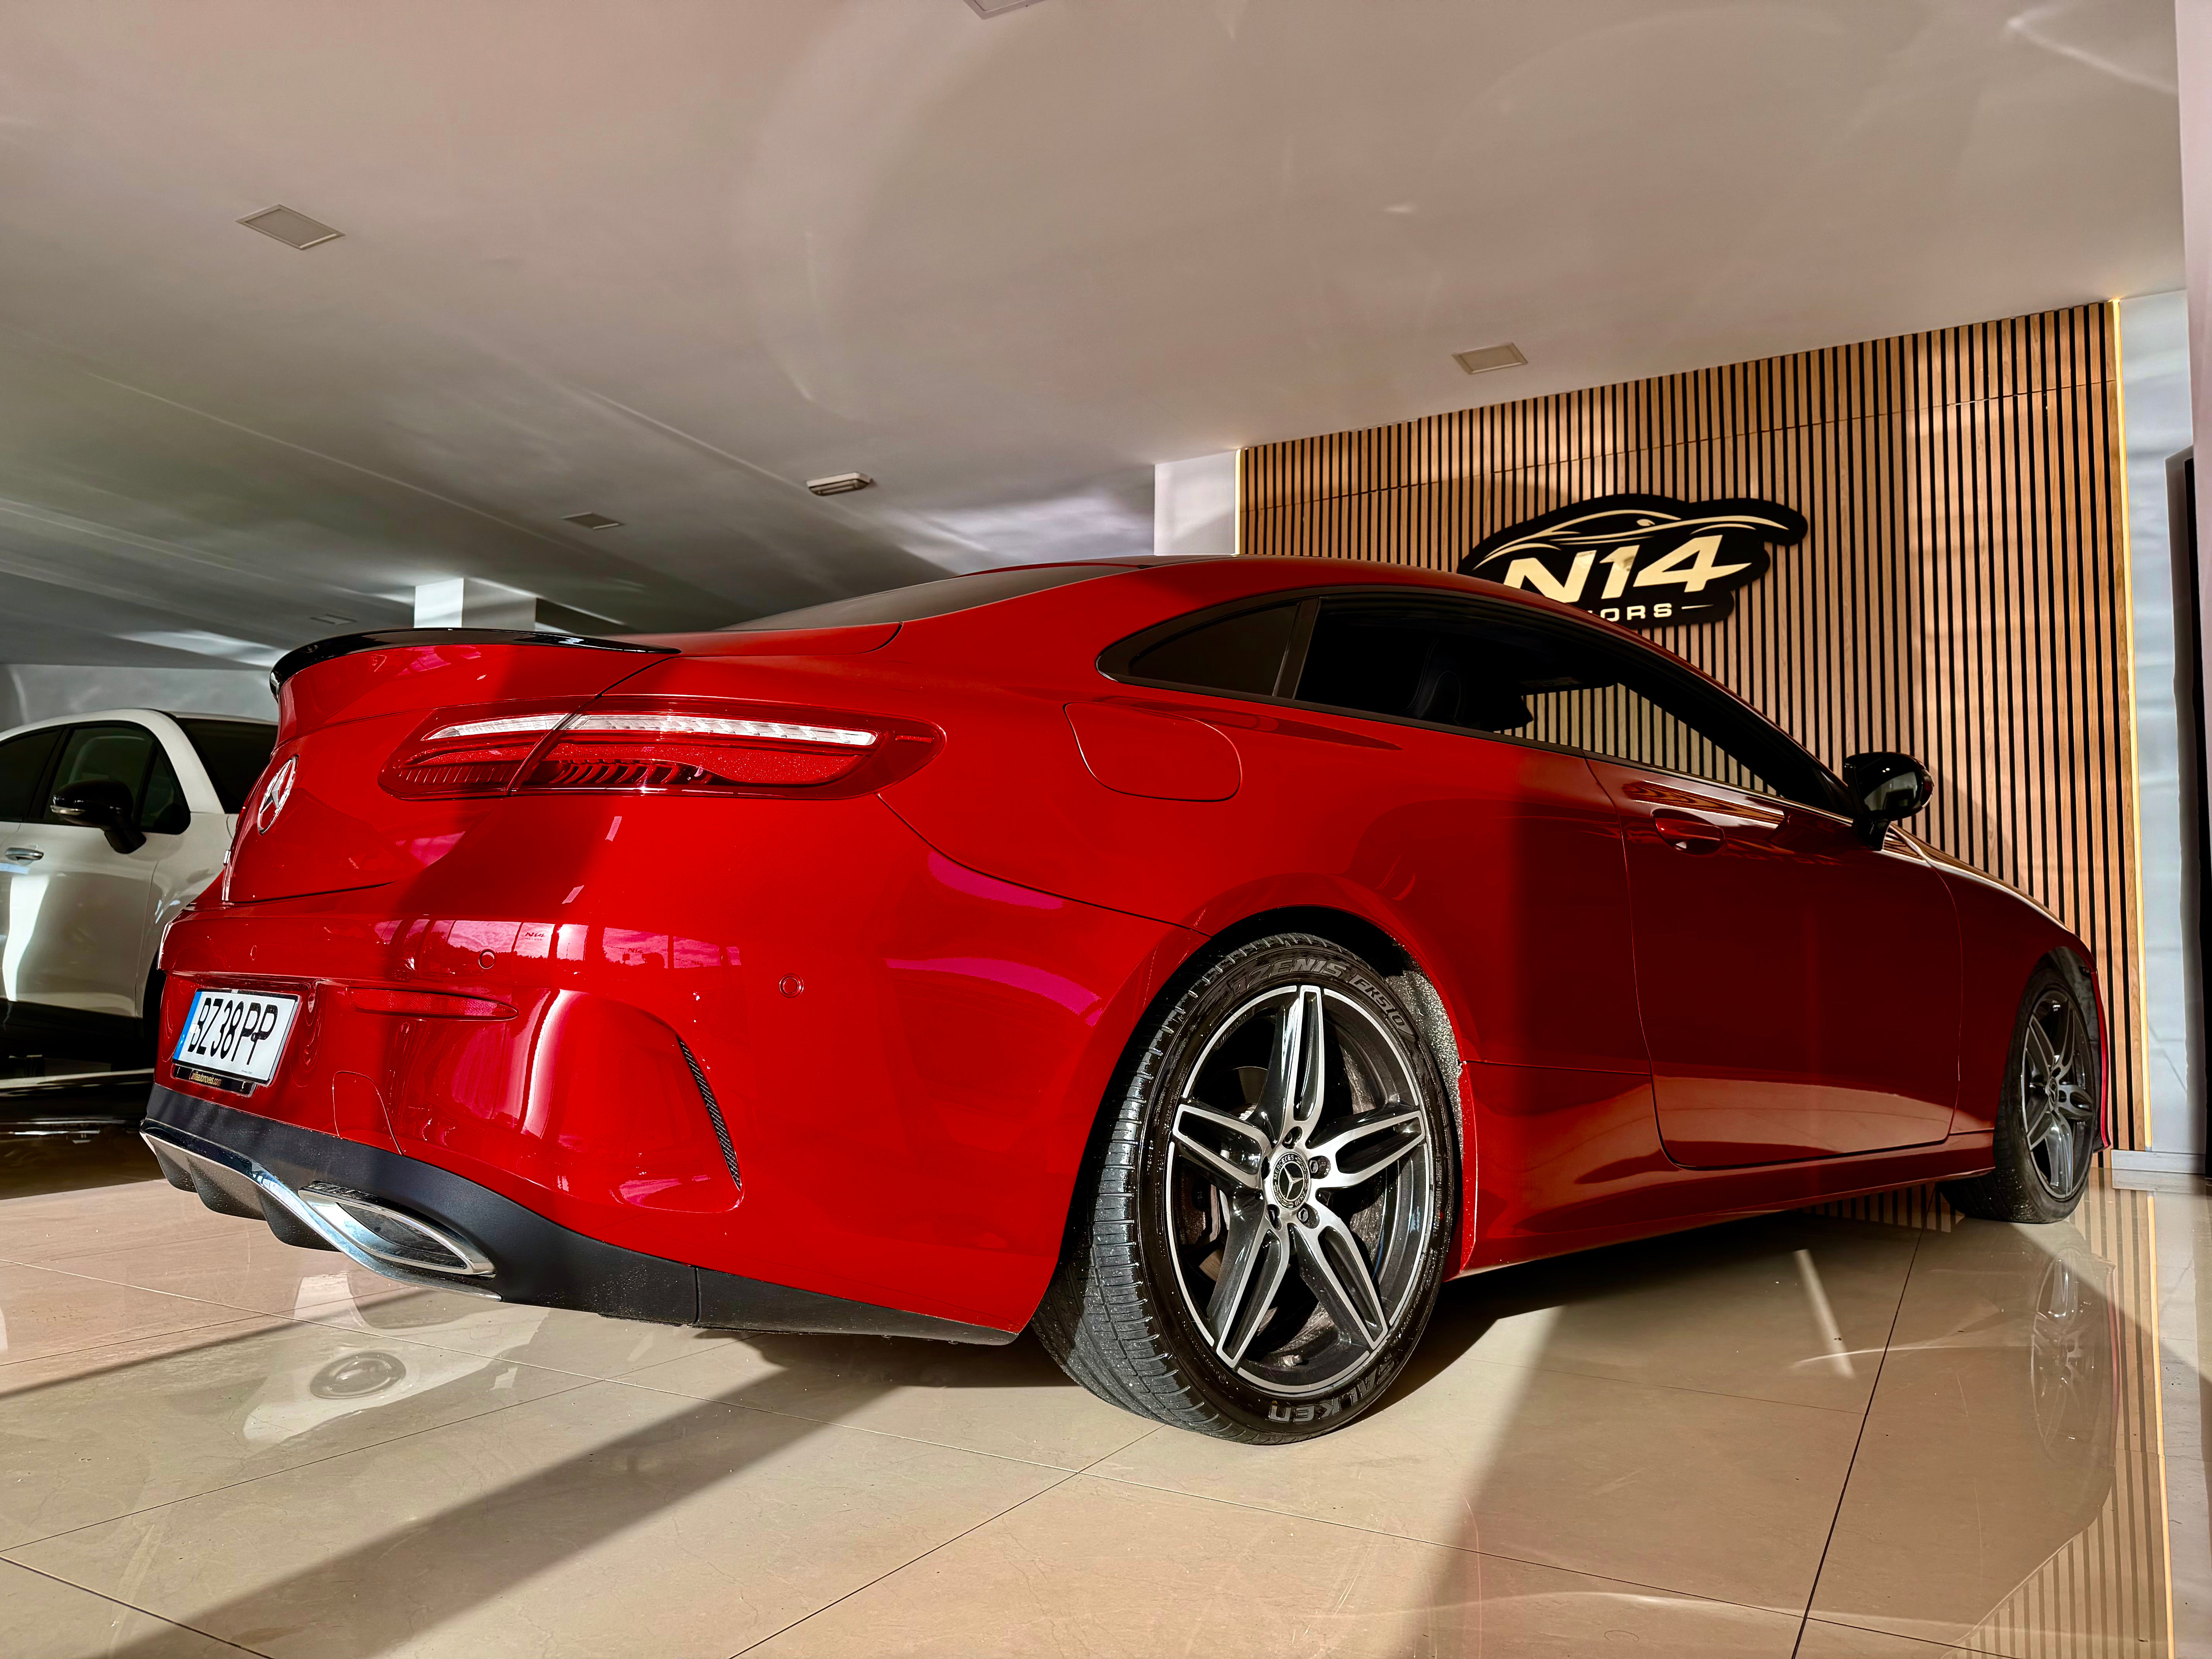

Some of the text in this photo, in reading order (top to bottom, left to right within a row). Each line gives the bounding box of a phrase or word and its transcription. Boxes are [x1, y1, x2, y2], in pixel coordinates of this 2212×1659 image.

[1503, 534, 1752, 603] N14
[1587, 603, 1672, 622] ORS
[1223, 958, 1405, 1027] AZENIS FK510
[1273, 1154, 1306, 1206] MERCEDES BENZ
